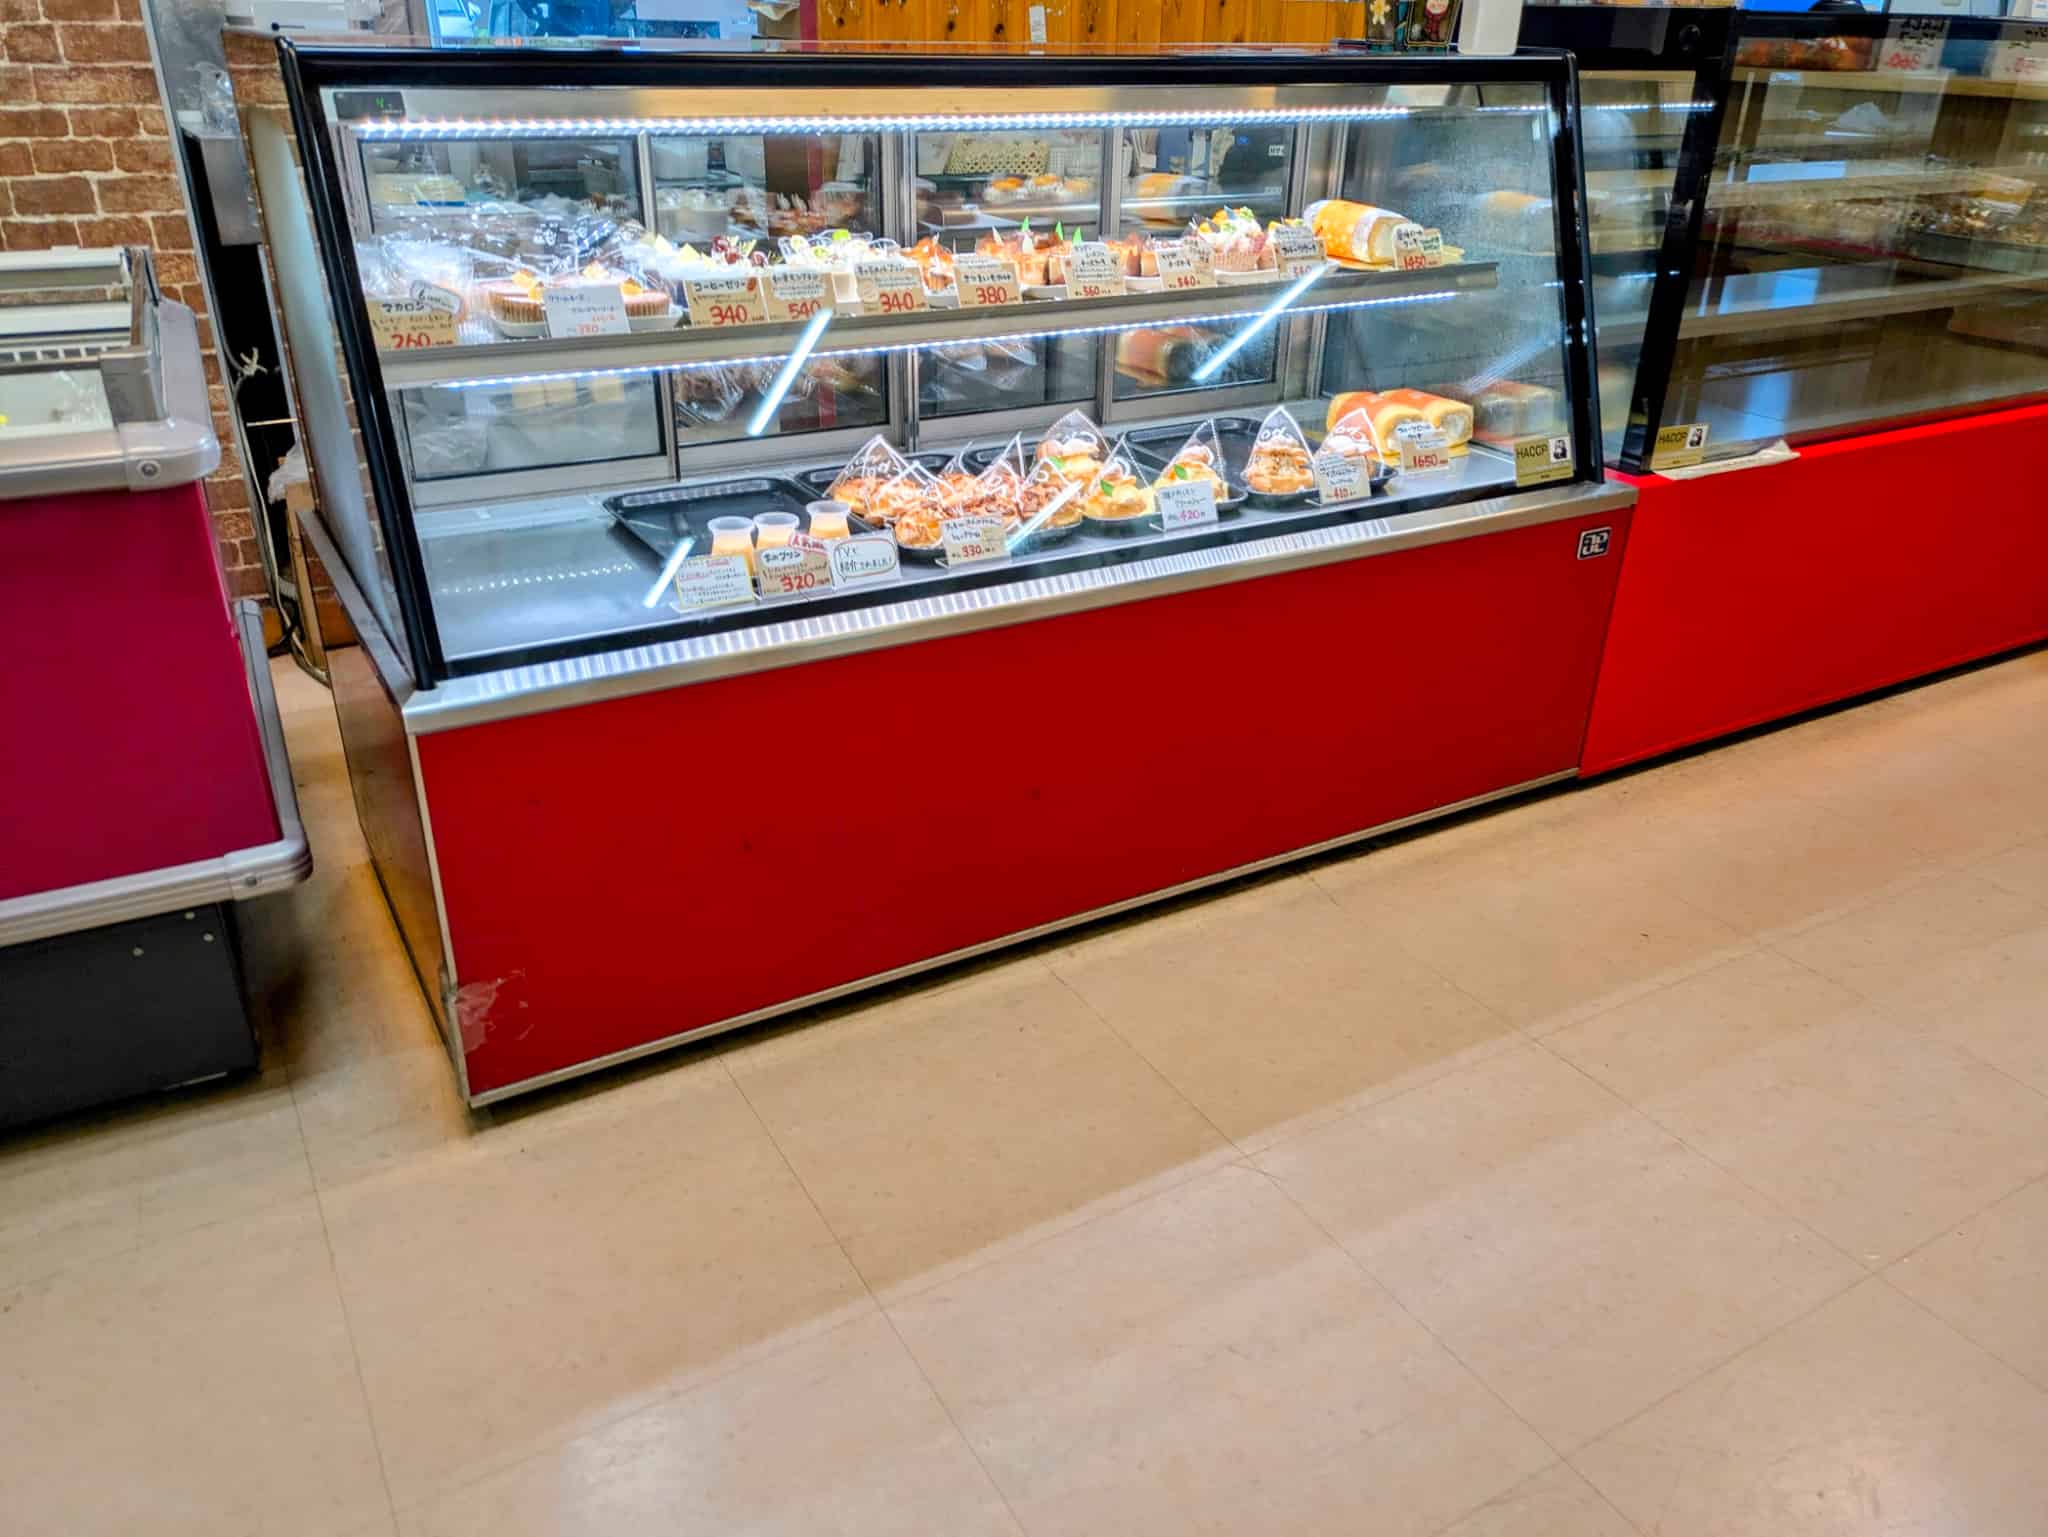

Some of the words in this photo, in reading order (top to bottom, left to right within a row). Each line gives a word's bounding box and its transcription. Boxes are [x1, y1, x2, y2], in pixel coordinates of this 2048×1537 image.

[880, 290, 914, 312] 340
[976, 286, 1007, 304] 380
[382, 300, 425, 312] マカロン
[710, 304, 748, 325] 340
[788, 300, 821, 319] 540
[391, 332, 431, 349] 260
[1413, 454, 1438, 468] 1650
[962, 544, 982, 558] 330
[780, 572, 815, 592] 320
